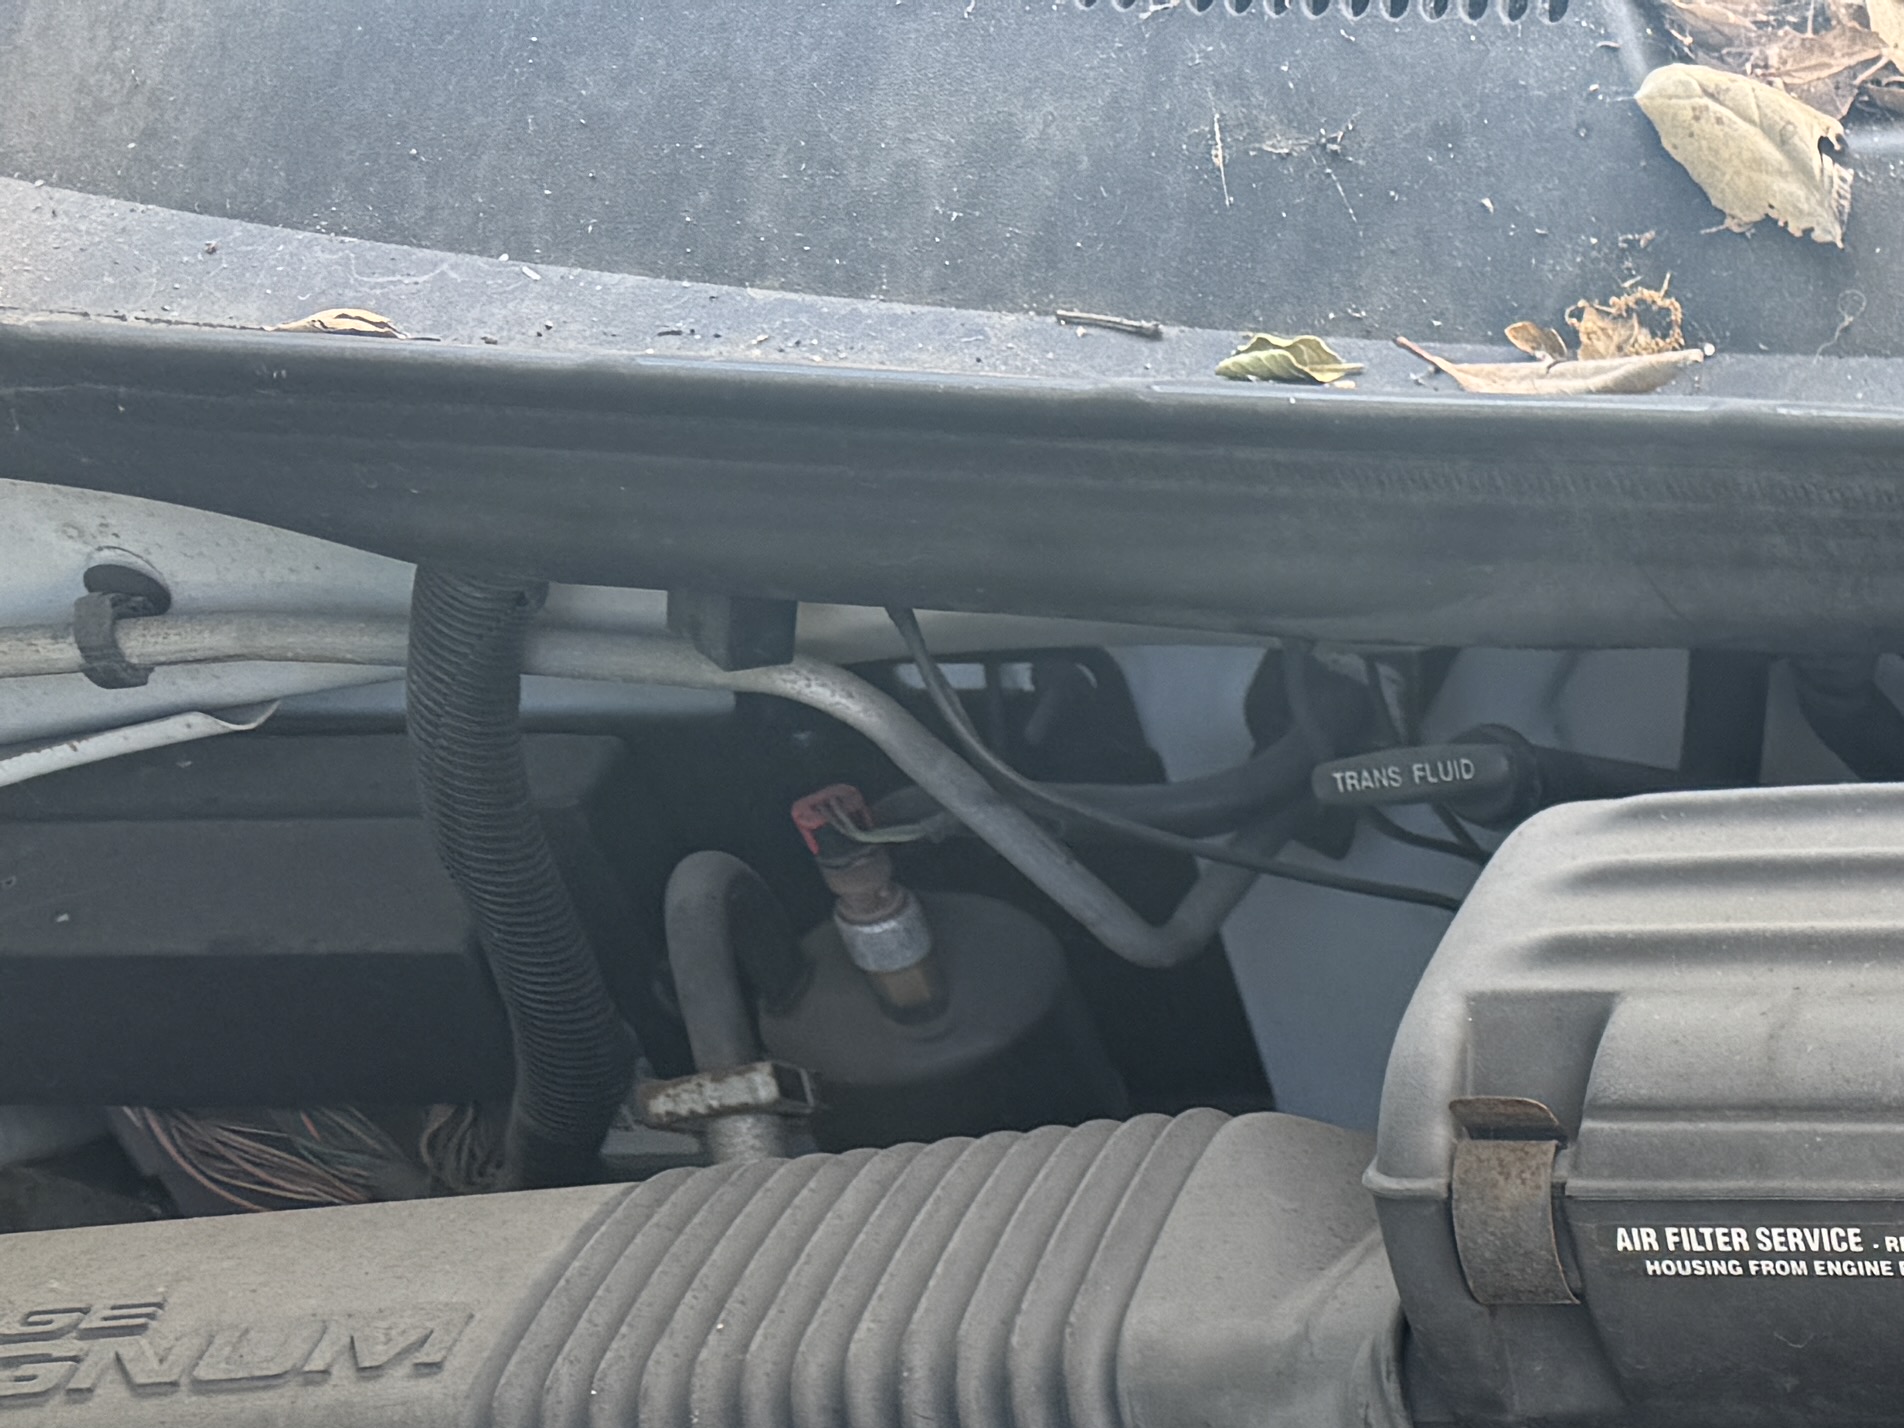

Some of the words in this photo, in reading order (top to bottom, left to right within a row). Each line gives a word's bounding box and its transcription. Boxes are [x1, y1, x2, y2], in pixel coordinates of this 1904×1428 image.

[1332, 765, 1401, 793] TRANS
[1412, 758, 1475, 783] FLUID
[1616, 1227, 1658, 1252] AIR
[1665, 1227, 1749, 1252] FILTER
[1756, 1227, 1864, 1252] SERVICE
[1645, 1259, 1744, 1276] HOUSING
[1748, 1260, 1809, 1276] FROM
[1814, 1260, 1893, 1276] ENGINE
